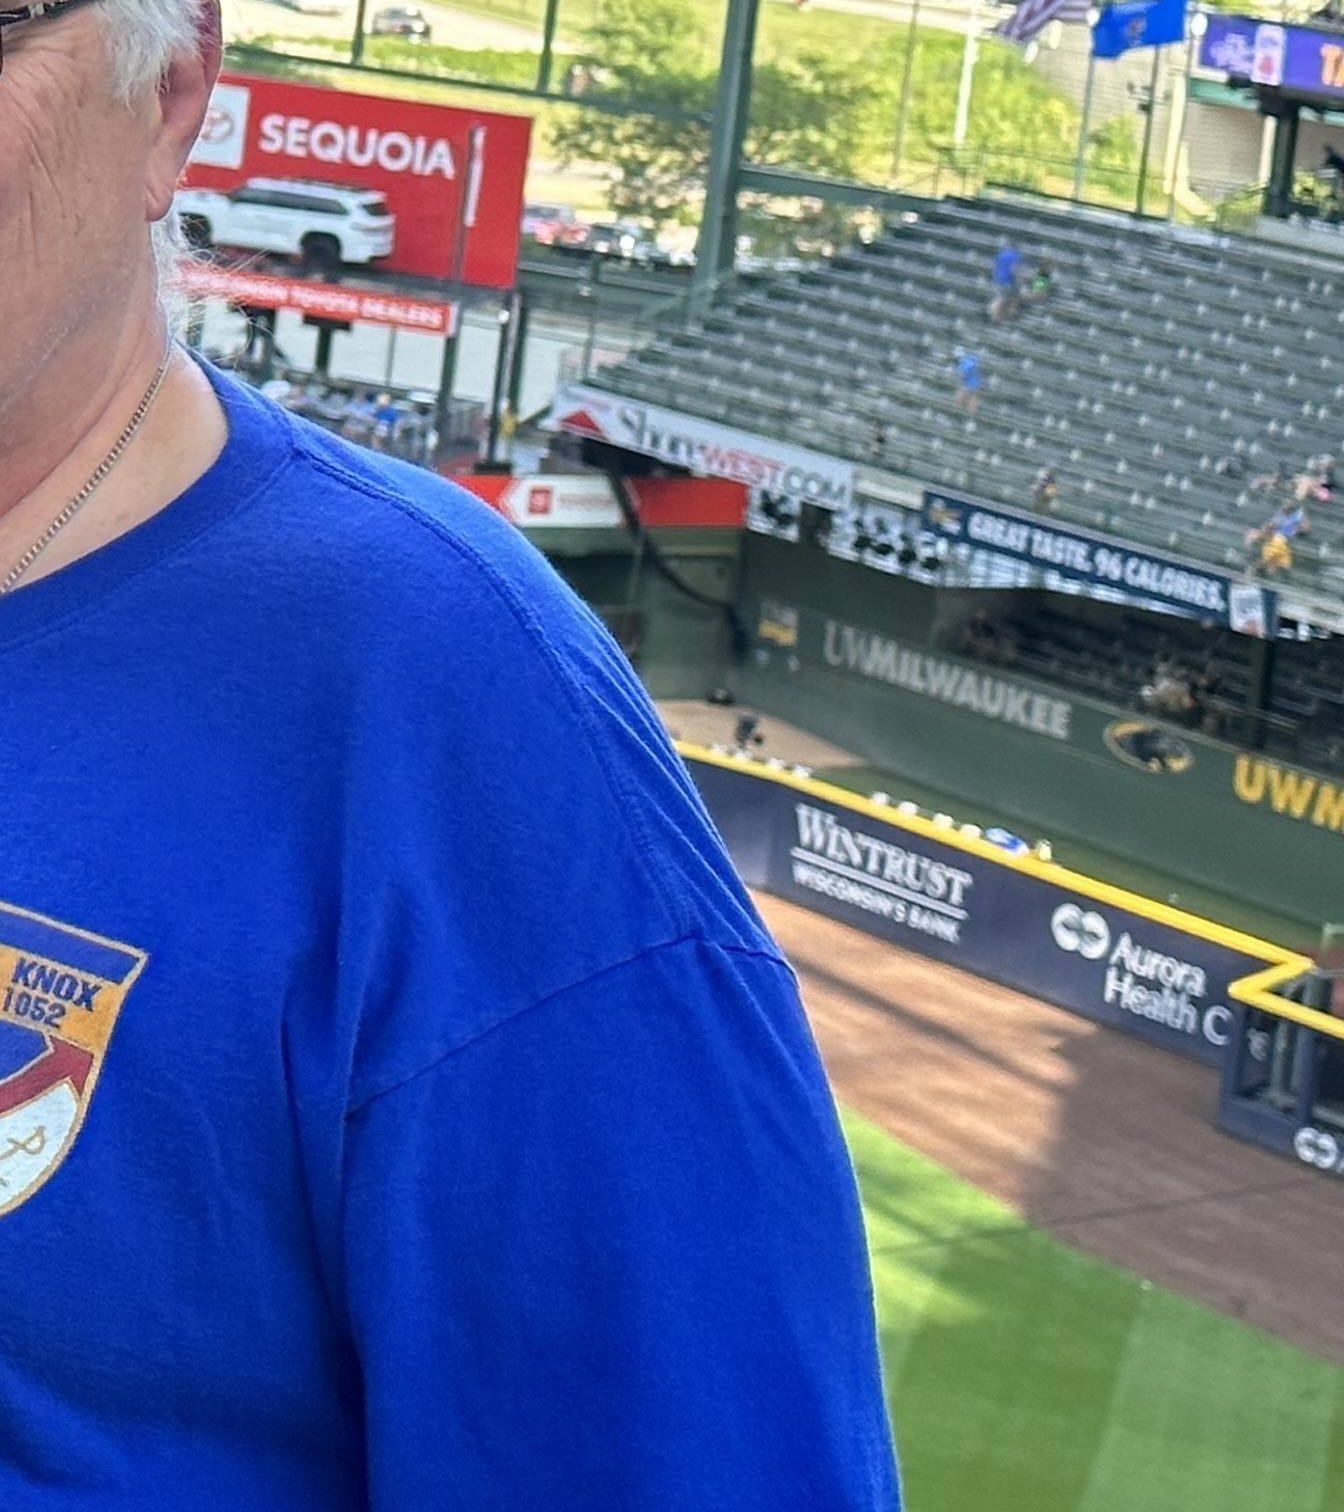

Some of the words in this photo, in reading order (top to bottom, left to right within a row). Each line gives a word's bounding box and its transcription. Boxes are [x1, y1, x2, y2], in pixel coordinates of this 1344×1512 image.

[258, 112, 456, 180] SEQUOIA
[362, 298, 444, 328] DEALERS
[968, 511, 1029, 553] GREAT
[1094, 548, 1123, 581] 96
[795, 802, 974, 905] WINTRUST
[907, 904, 961, 944] BANK
[11, 956, 103, 1013] KNOX
[1110, 933, 1207, 997] Aurora
[1, 987, 66, 1029] 1052
[1104, 967, 1198, 1034] Health
